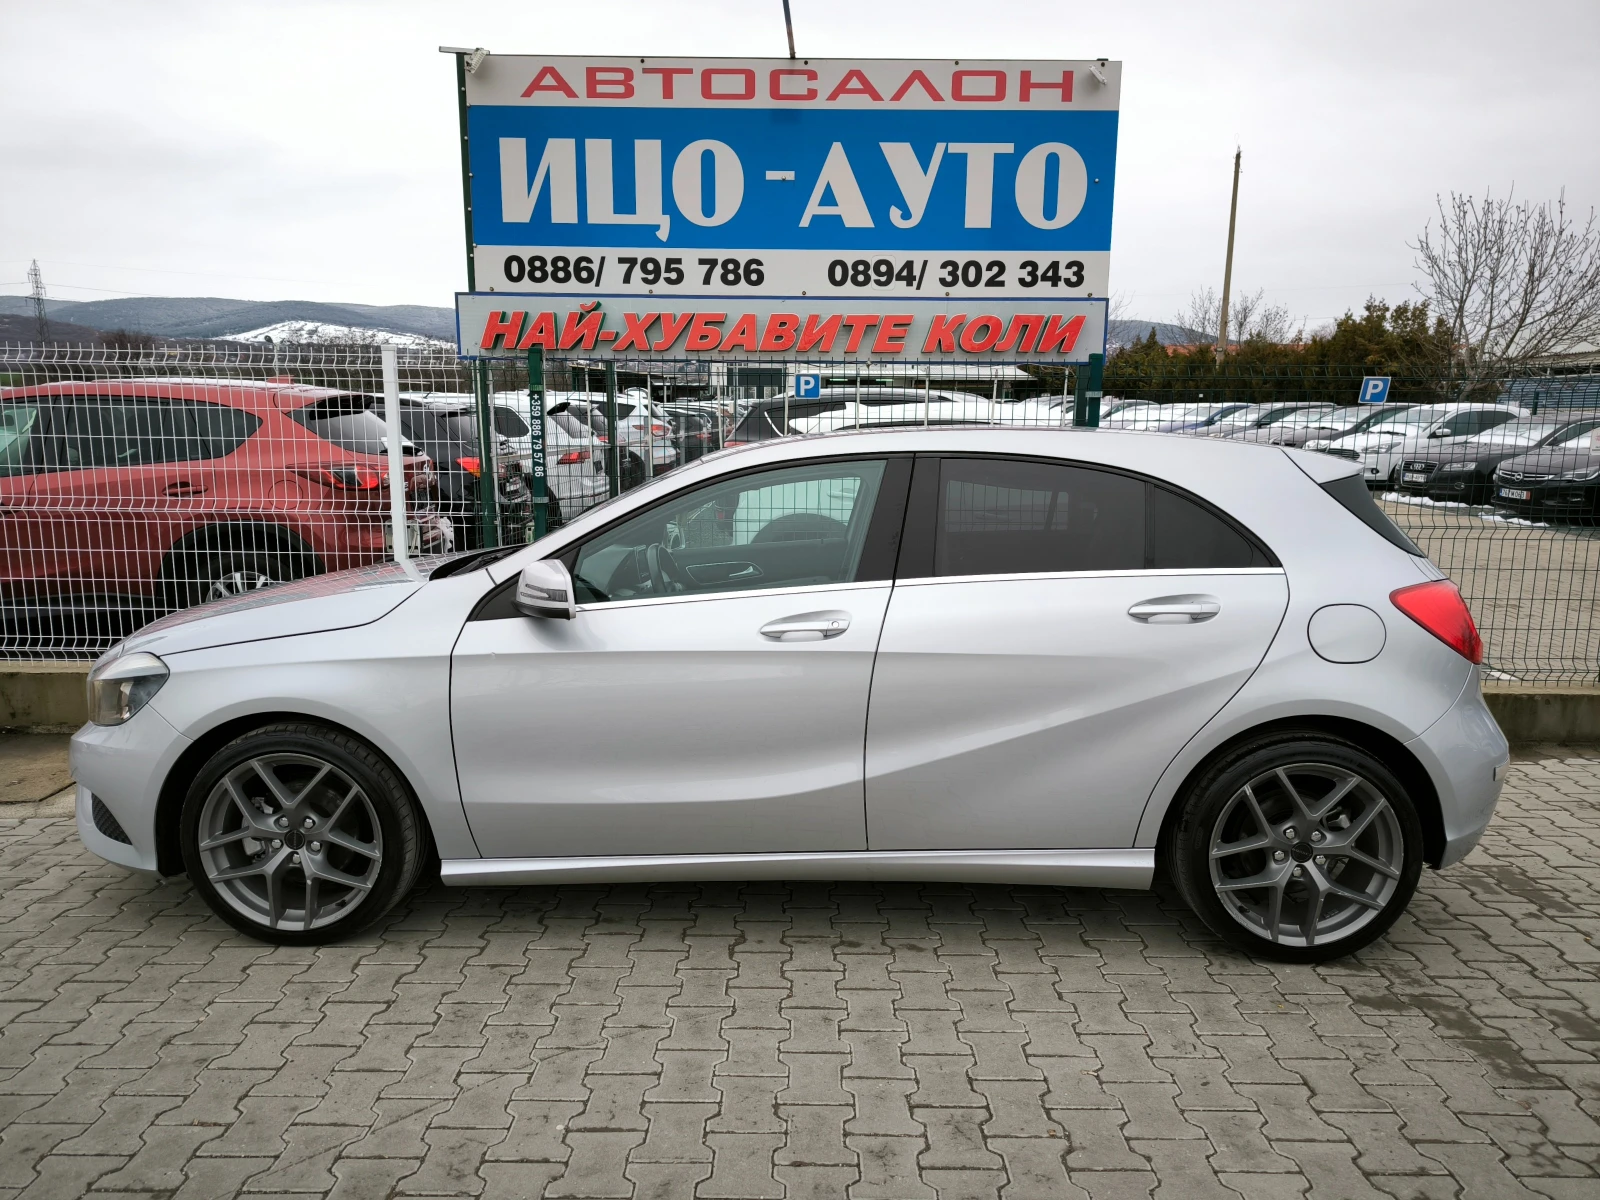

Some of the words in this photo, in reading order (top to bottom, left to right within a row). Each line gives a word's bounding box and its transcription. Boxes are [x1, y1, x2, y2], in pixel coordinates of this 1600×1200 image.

[520, 66, 1074, 102] АВТОСАЛОН
[498, 136, 745, 243] ИЦО
[798, 141, 1089, 230] АУТО
[503, 254, 606, 287] 0886/
[617, 256, 685, 286] 795
[697, 257, 765, 287] 786
[827, 259, 929, 291] 0894/
[938, 260, 1007, 288] 302
[1017, 260, 1085, 288] 343
[479, 300, 915, 354] НАЙ-ХУБАВИТЕ
[921, 313, 1088, 354] КОЛИ
[800, 376, 815, 396] P
[1365, 380, 1384, 400] P
[531, 393, 541, 417] +359
[532, 419, 542, 436] 886
[533, 438, 543, 450] 79
[534, 452, 543, 464] 57
[535, 466, 545, 477] 86
